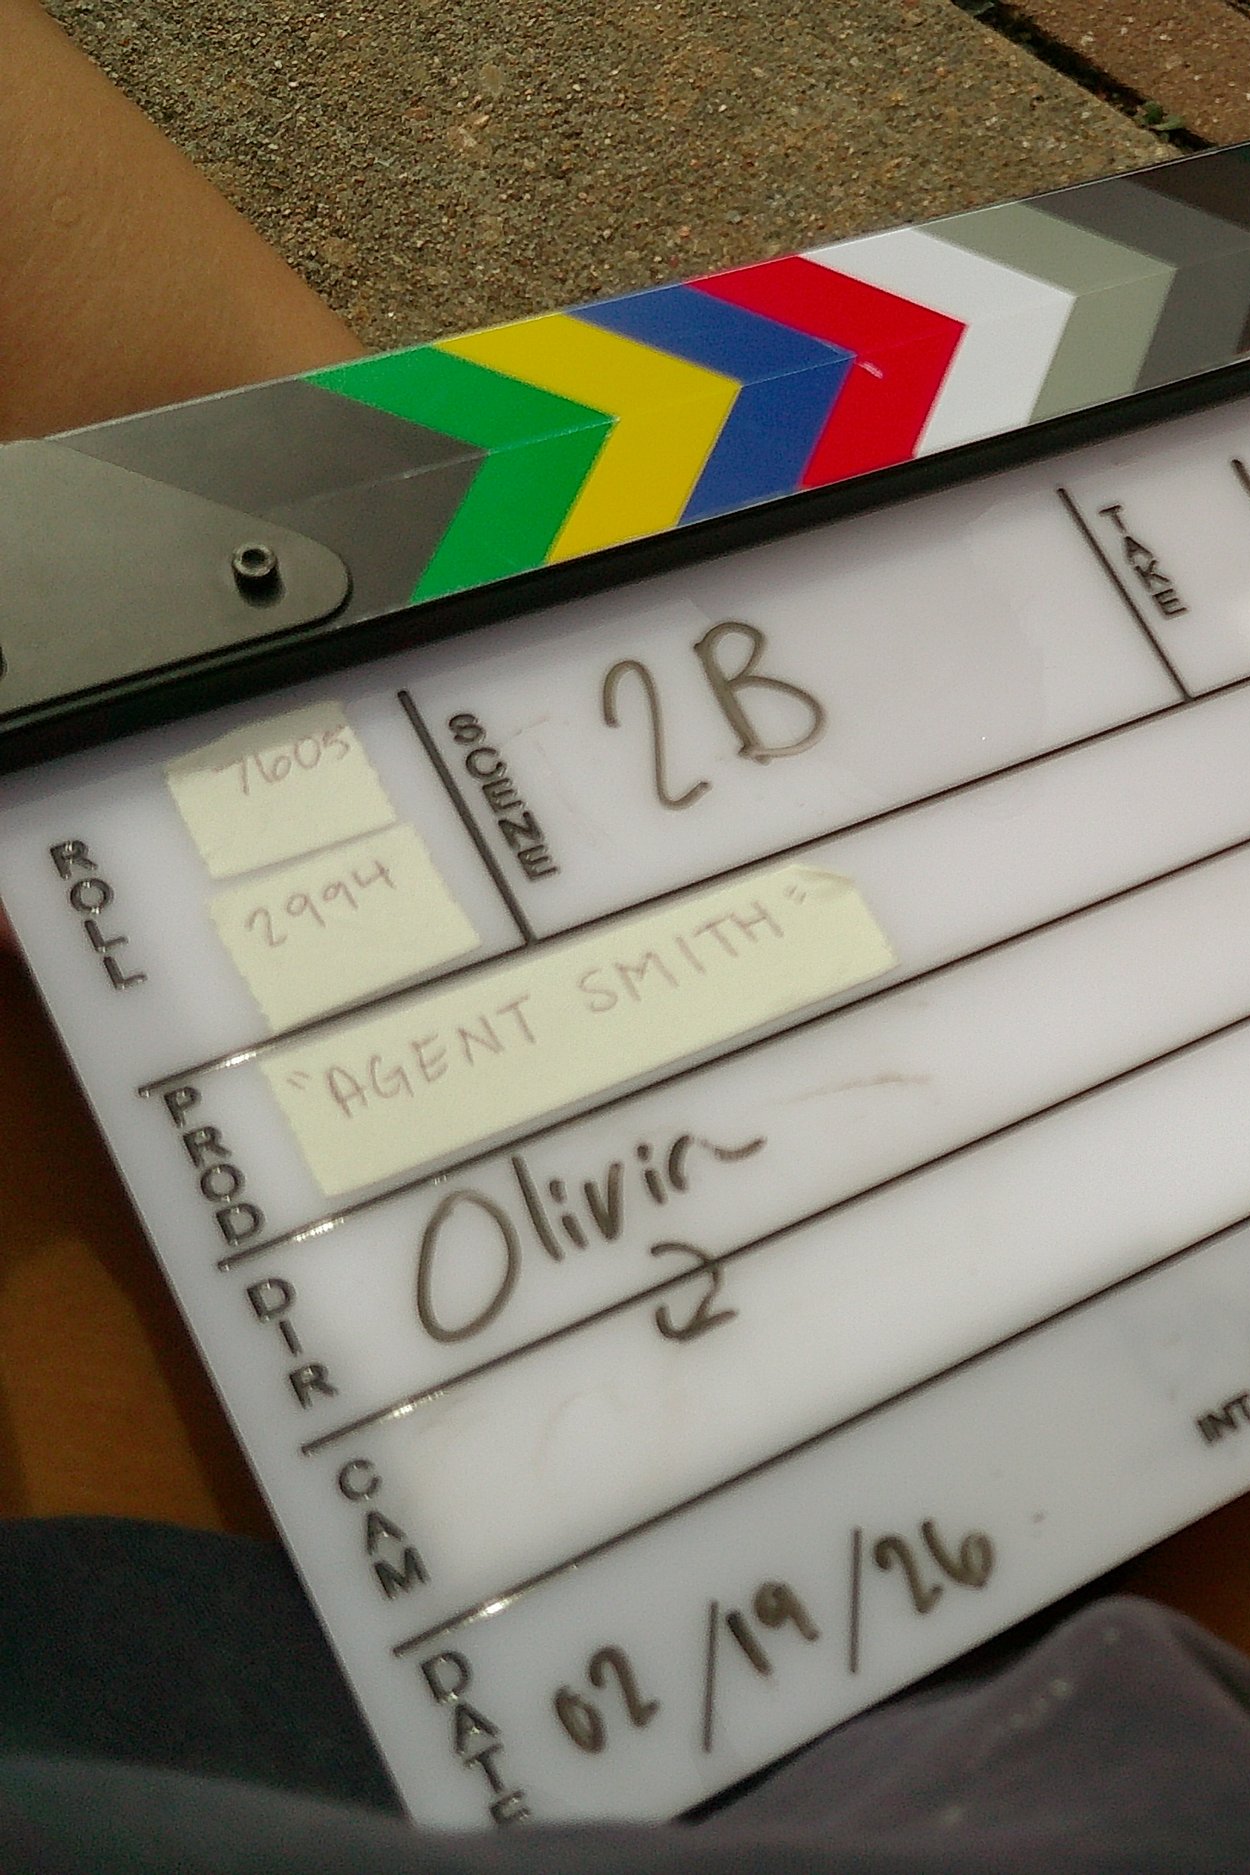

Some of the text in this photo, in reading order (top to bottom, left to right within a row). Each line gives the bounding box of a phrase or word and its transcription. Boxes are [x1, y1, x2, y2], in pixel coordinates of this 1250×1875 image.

[1099, 504, 1188, 619] TAKE
[603, 620, 828, 812] 2B
[448, 712, 561, 882] SCENE
[49, 838, 147, 991] ROLL
[245, 861, 400, 949] 2994
[163, 1085, 266, 1247] PROD
[246, 1276, 339, 1409] DIR
[337, 1457, 431, 1600] CAM
